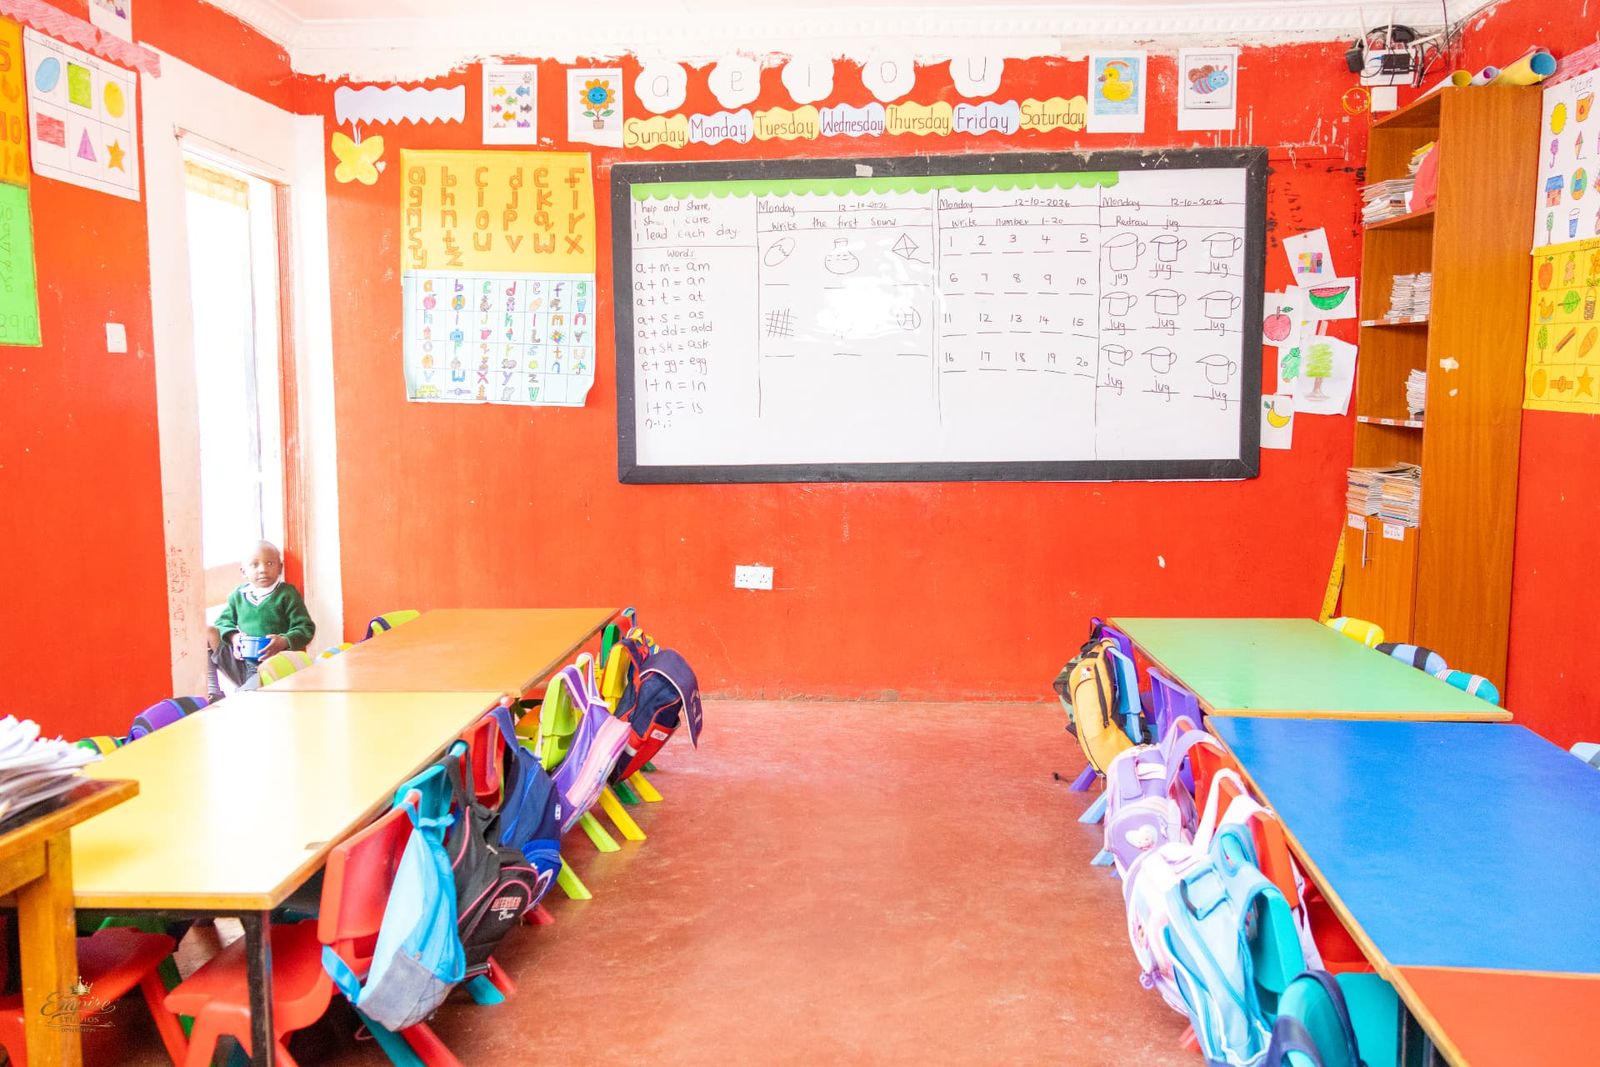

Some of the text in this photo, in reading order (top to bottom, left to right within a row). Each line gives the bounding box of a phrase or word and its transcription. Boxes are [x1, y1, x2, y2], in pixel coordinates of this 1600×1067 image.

[652, 75, 670, 97] a
[731, 71, 744, 92] e
[627, 104, 1085, 147] Sunday Monday Tuesday Wednesday Thursday Friday Saturday
[408, 166, 584, 188] a b c d e f
[409, 186, 422, 207] g
[441, 187, 455, 206] h
[1102, 197, 1140, 211] Monday
[664, 200, 680, 212] and
[758, 201, 796, 216] Monday
[939, 199, 973, 213] Monday
[407, 208, 422, 226] m
[441, 210, 457, 228] n
[534, 211, 554, 231] q
[569, 212, 585, 233] r
[812, 217, 826, 228] the
[838, 216, 858, 229] first
[1116, 216, 1149, 226] Redraw
[647, 228, 668, 240] lead
[716, 224, 737, 239] day
[978, 235, 987, 246] 2
[1010, 234, 1017, 243] 3
[1042, 235, 1051, 244] 4
[1080, 233, 1089, 243] 5
[412, 250, 427, 269] y
[635, 263, 646, 274] a
[660, 264, 670, 272] m
[687, 262, 710, 272] am
[634, 282, 645, 291] a
[662, 278, 669, 287] n
[687, 277, 705, 286] an
[950, 273, 1086, 286] 6 7 8 9 10
[423, 280, 433, 292] a
[454, 279, 463, 292] b
[506, 281, 517, 296] d
[553, 282, 565, 297] f
[576, 281, 587, 297] g
[637, 298, 645, 306] a
[661, 293, 668, 304] t
[689, 291, 704, 302] at
[552, 313, 586, 326] m n
[638, 317, 647, 325] a
[944, 313, 1084, 326] 11 12 13 14 15
[638, 330, 648, 339] a
[662, 324, 677, 336] dd
[691, 321, 712, 332] add
[639, 346, 648, 355] a
[688, 339, 710, 349] ask
[642, 362, 649, 371] e
[690, 357, 707, 375] egg
[945, 351, 1089, 367] 16 17 18 19 20
[665, 380, 672, 391] n
